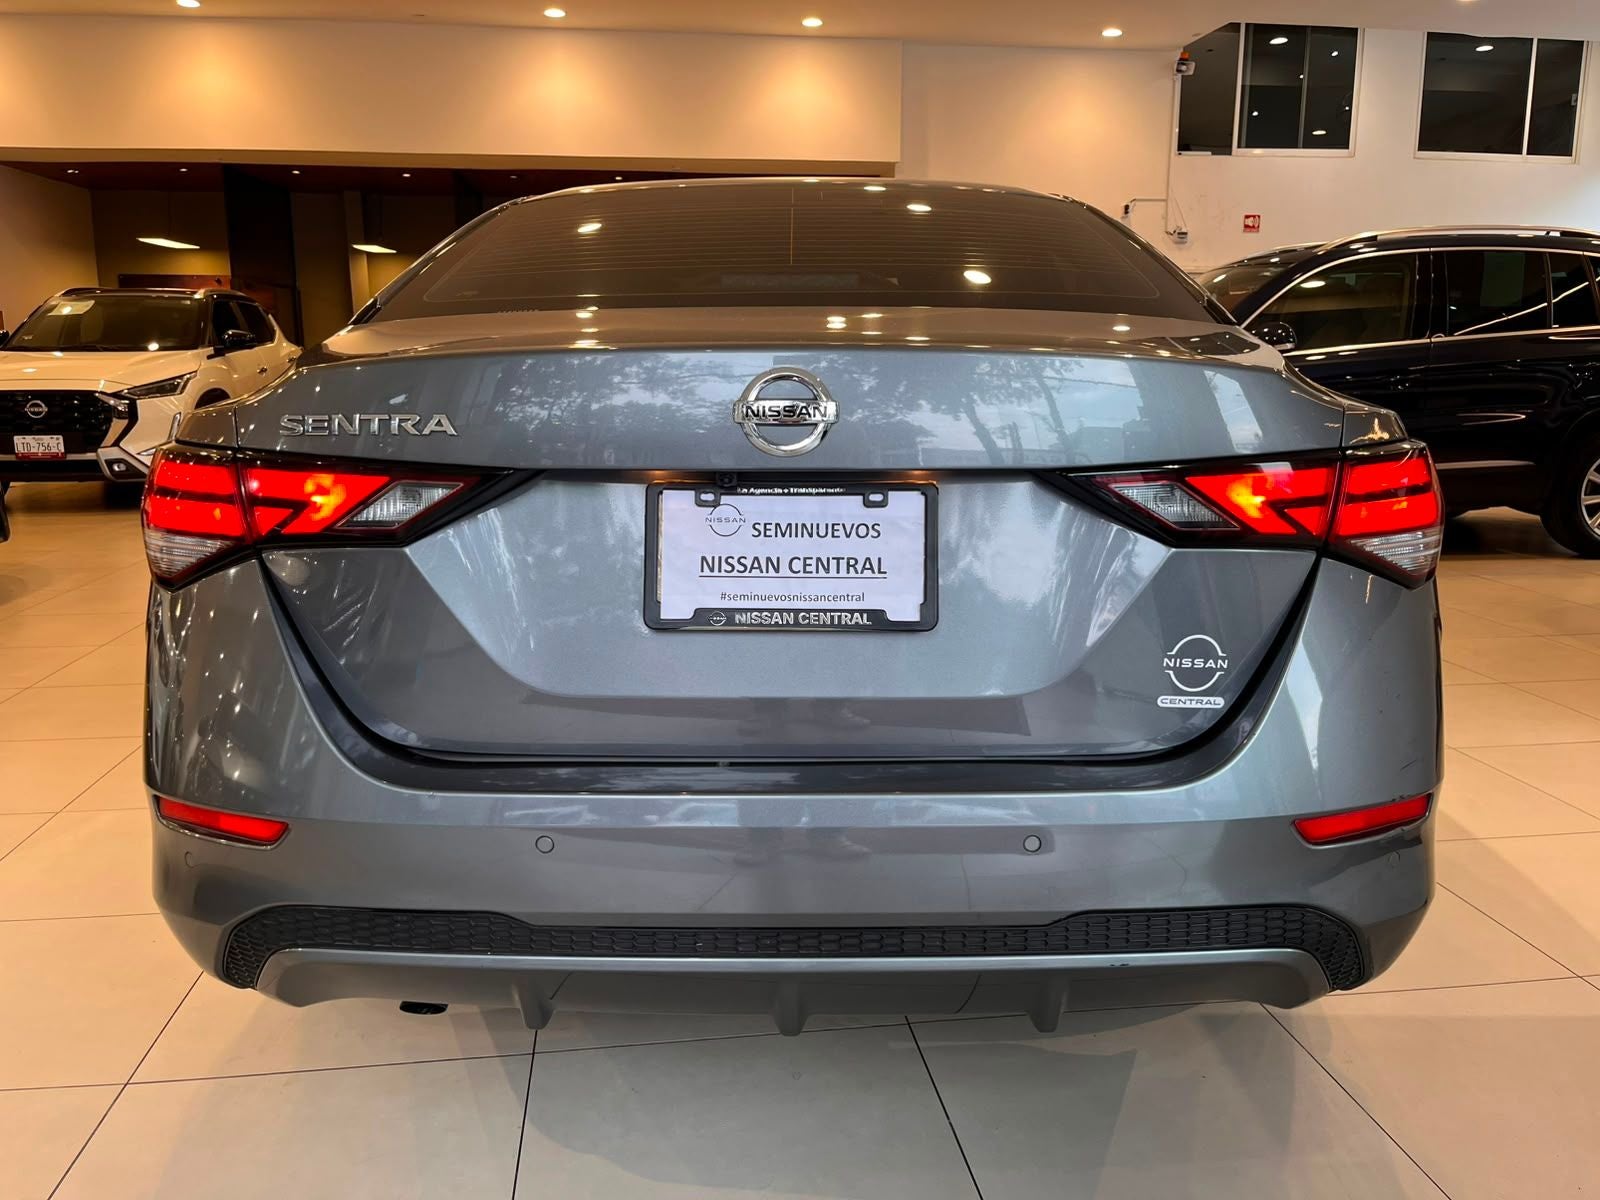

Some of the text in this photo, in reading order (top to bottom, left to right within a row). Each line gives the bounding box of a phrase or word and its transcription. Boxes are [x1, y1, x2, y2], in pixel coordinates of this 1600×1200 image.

[745, 405, 828, 418] NISSAN
[279, 413, 458, 436] SENTRA
[751, 522, 881, 539] SEMINUEVOS
[700, 555, 887, 575] NISSAN CENTRAL
[720, 591, 865, 602] #seminuevosnissancentral
[734, 611, 794, 625] NISSAN
[798, 612, 872, 625] CENTRAL
[1163, 657, 1228, 669] NISSAN
[1160, 697, 1222, 706] CENTRAL
